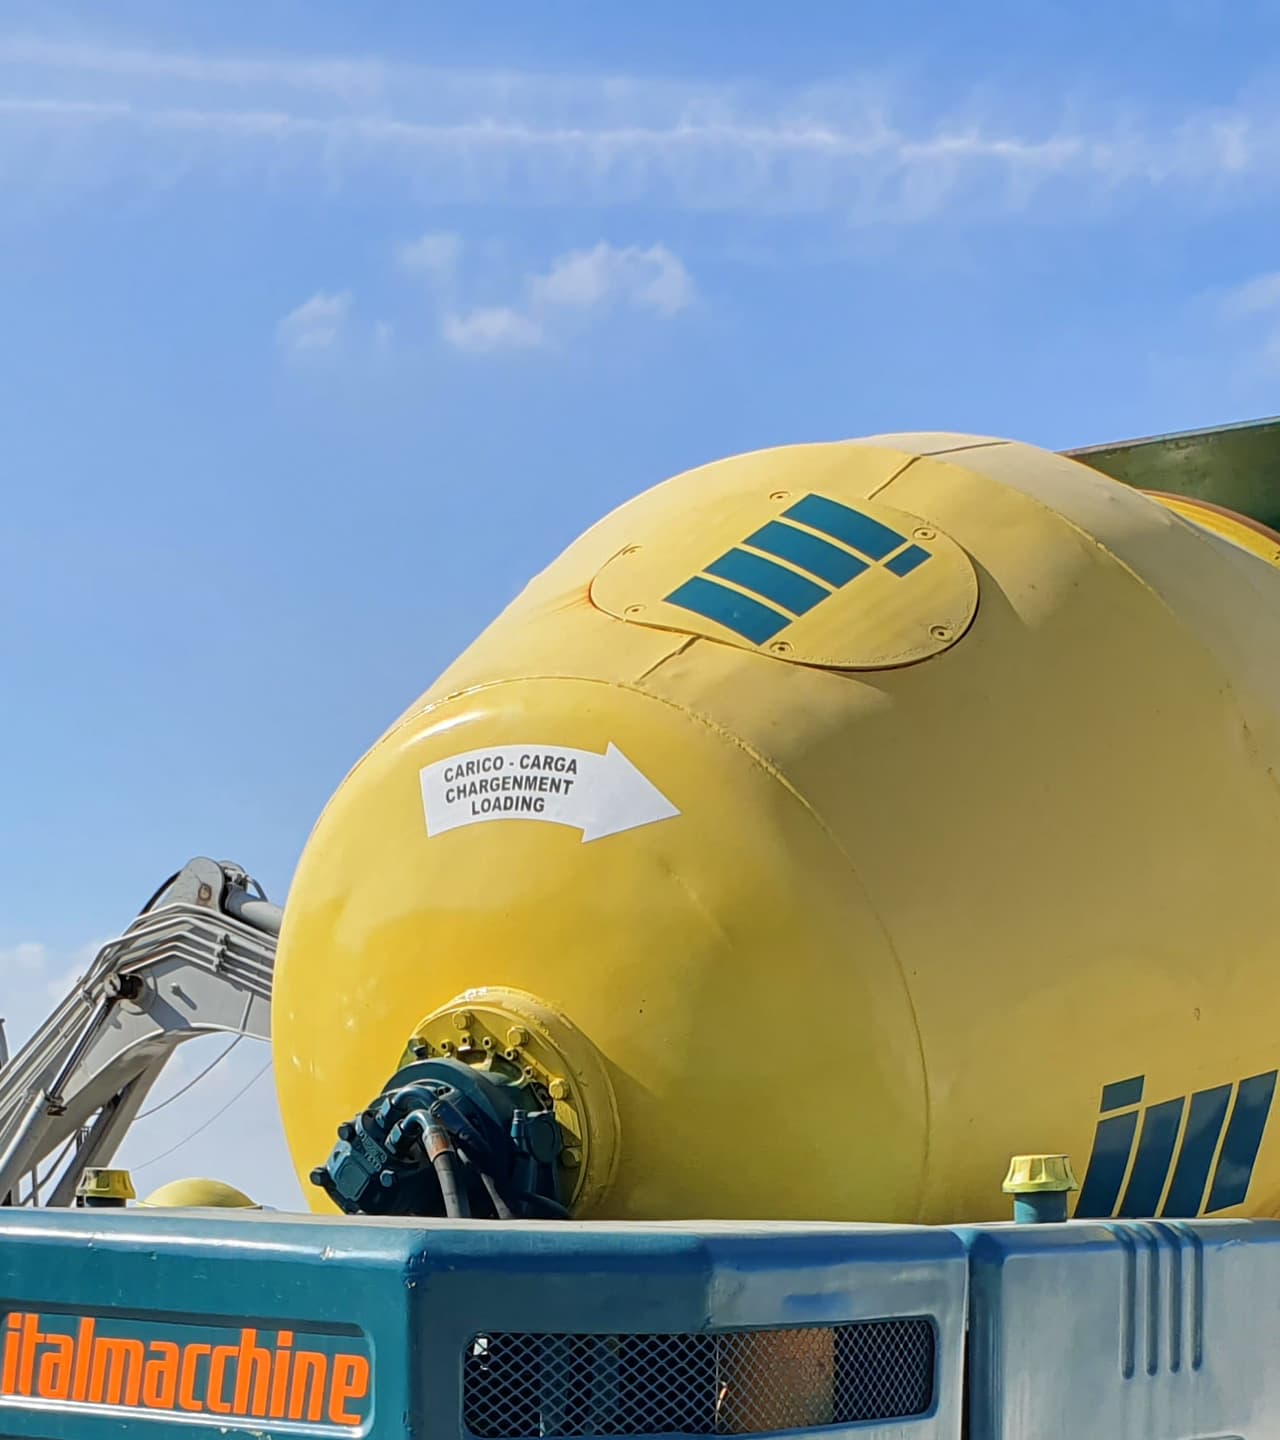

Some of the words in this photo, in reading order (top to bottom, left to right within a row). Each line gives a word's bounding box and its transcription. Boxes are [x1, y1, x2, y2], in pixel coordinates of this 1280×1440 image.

[444, 756, 504, 783] CARICO
[519, 754, 578, 775] CARGA
[445, 775, 574, 804] CHARGENMENT
[471, 795, 546, 816] LOADING
[0, 1312, 370, 1425] italmacchine
